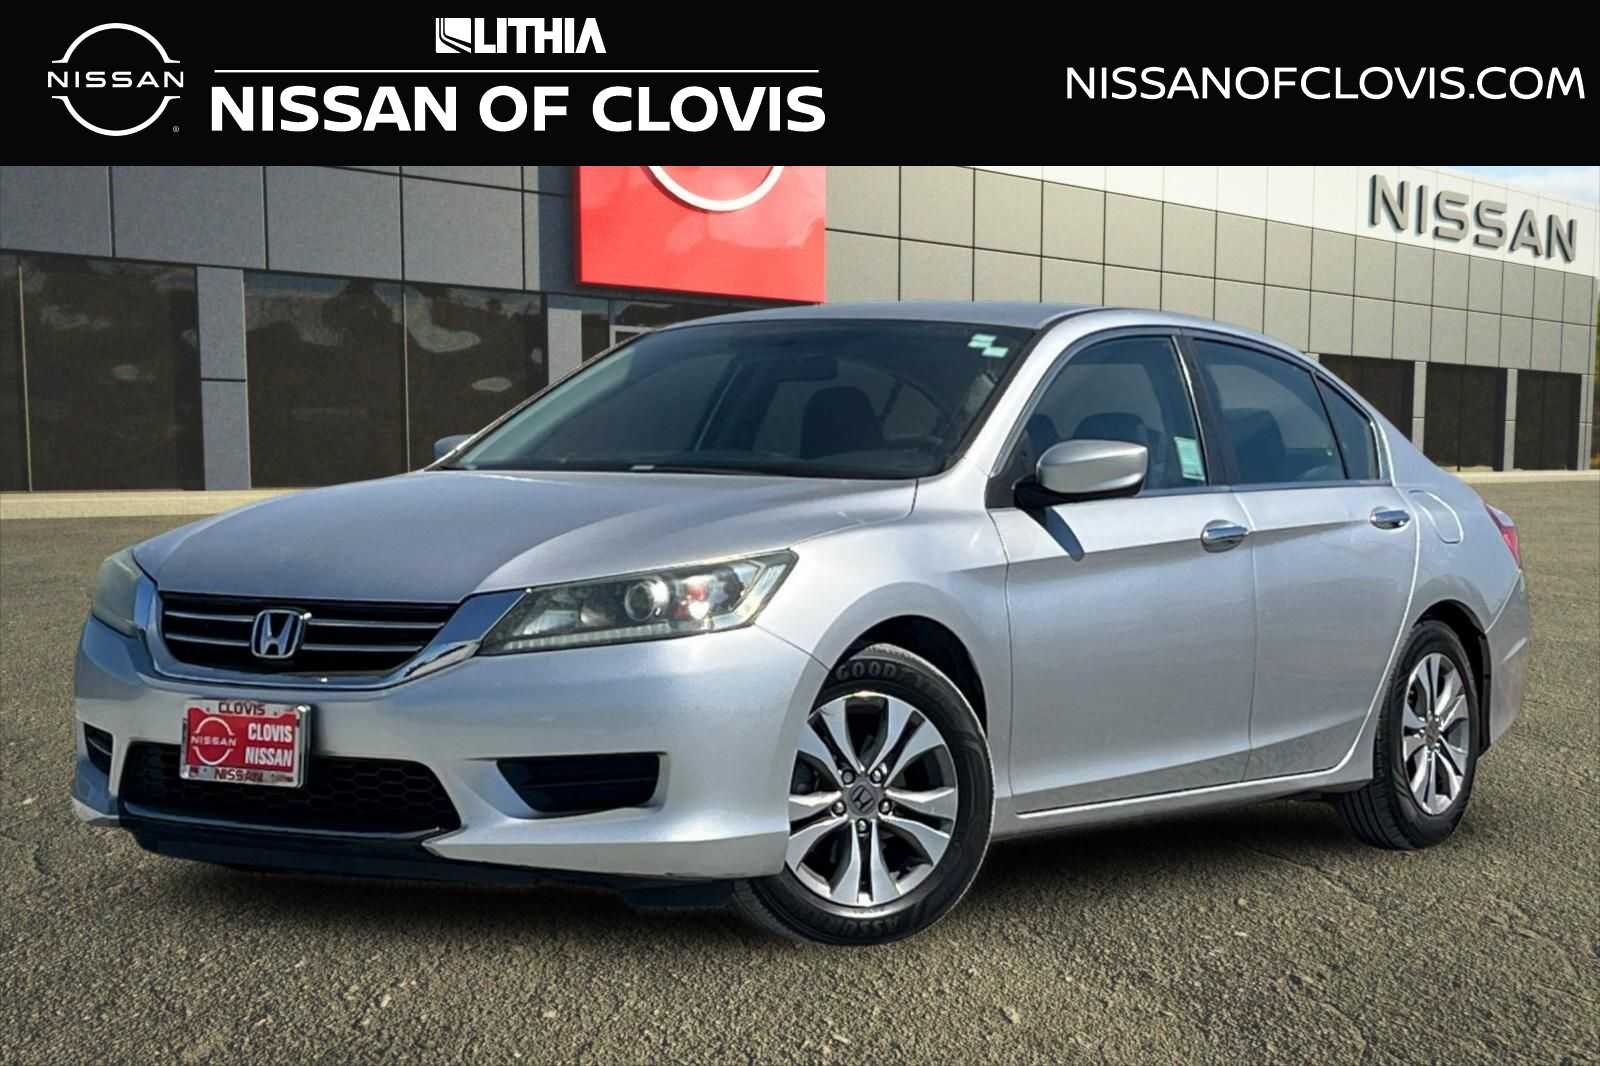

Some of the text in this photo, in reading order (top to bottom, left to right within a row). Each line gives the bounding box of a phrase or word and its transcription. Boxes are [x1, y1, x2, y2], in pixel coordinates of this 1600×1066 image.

[1369, 174, 1577, 263] NISSAN
[218, 702, 266, 715] CLOVIS
[191, 735, 237, 747] NISSAN
[248, 723, 293, 743] CLOVIS
[245, 746, 293, 767] NISSAN
[214, 768, 264, 782] NISSAN
